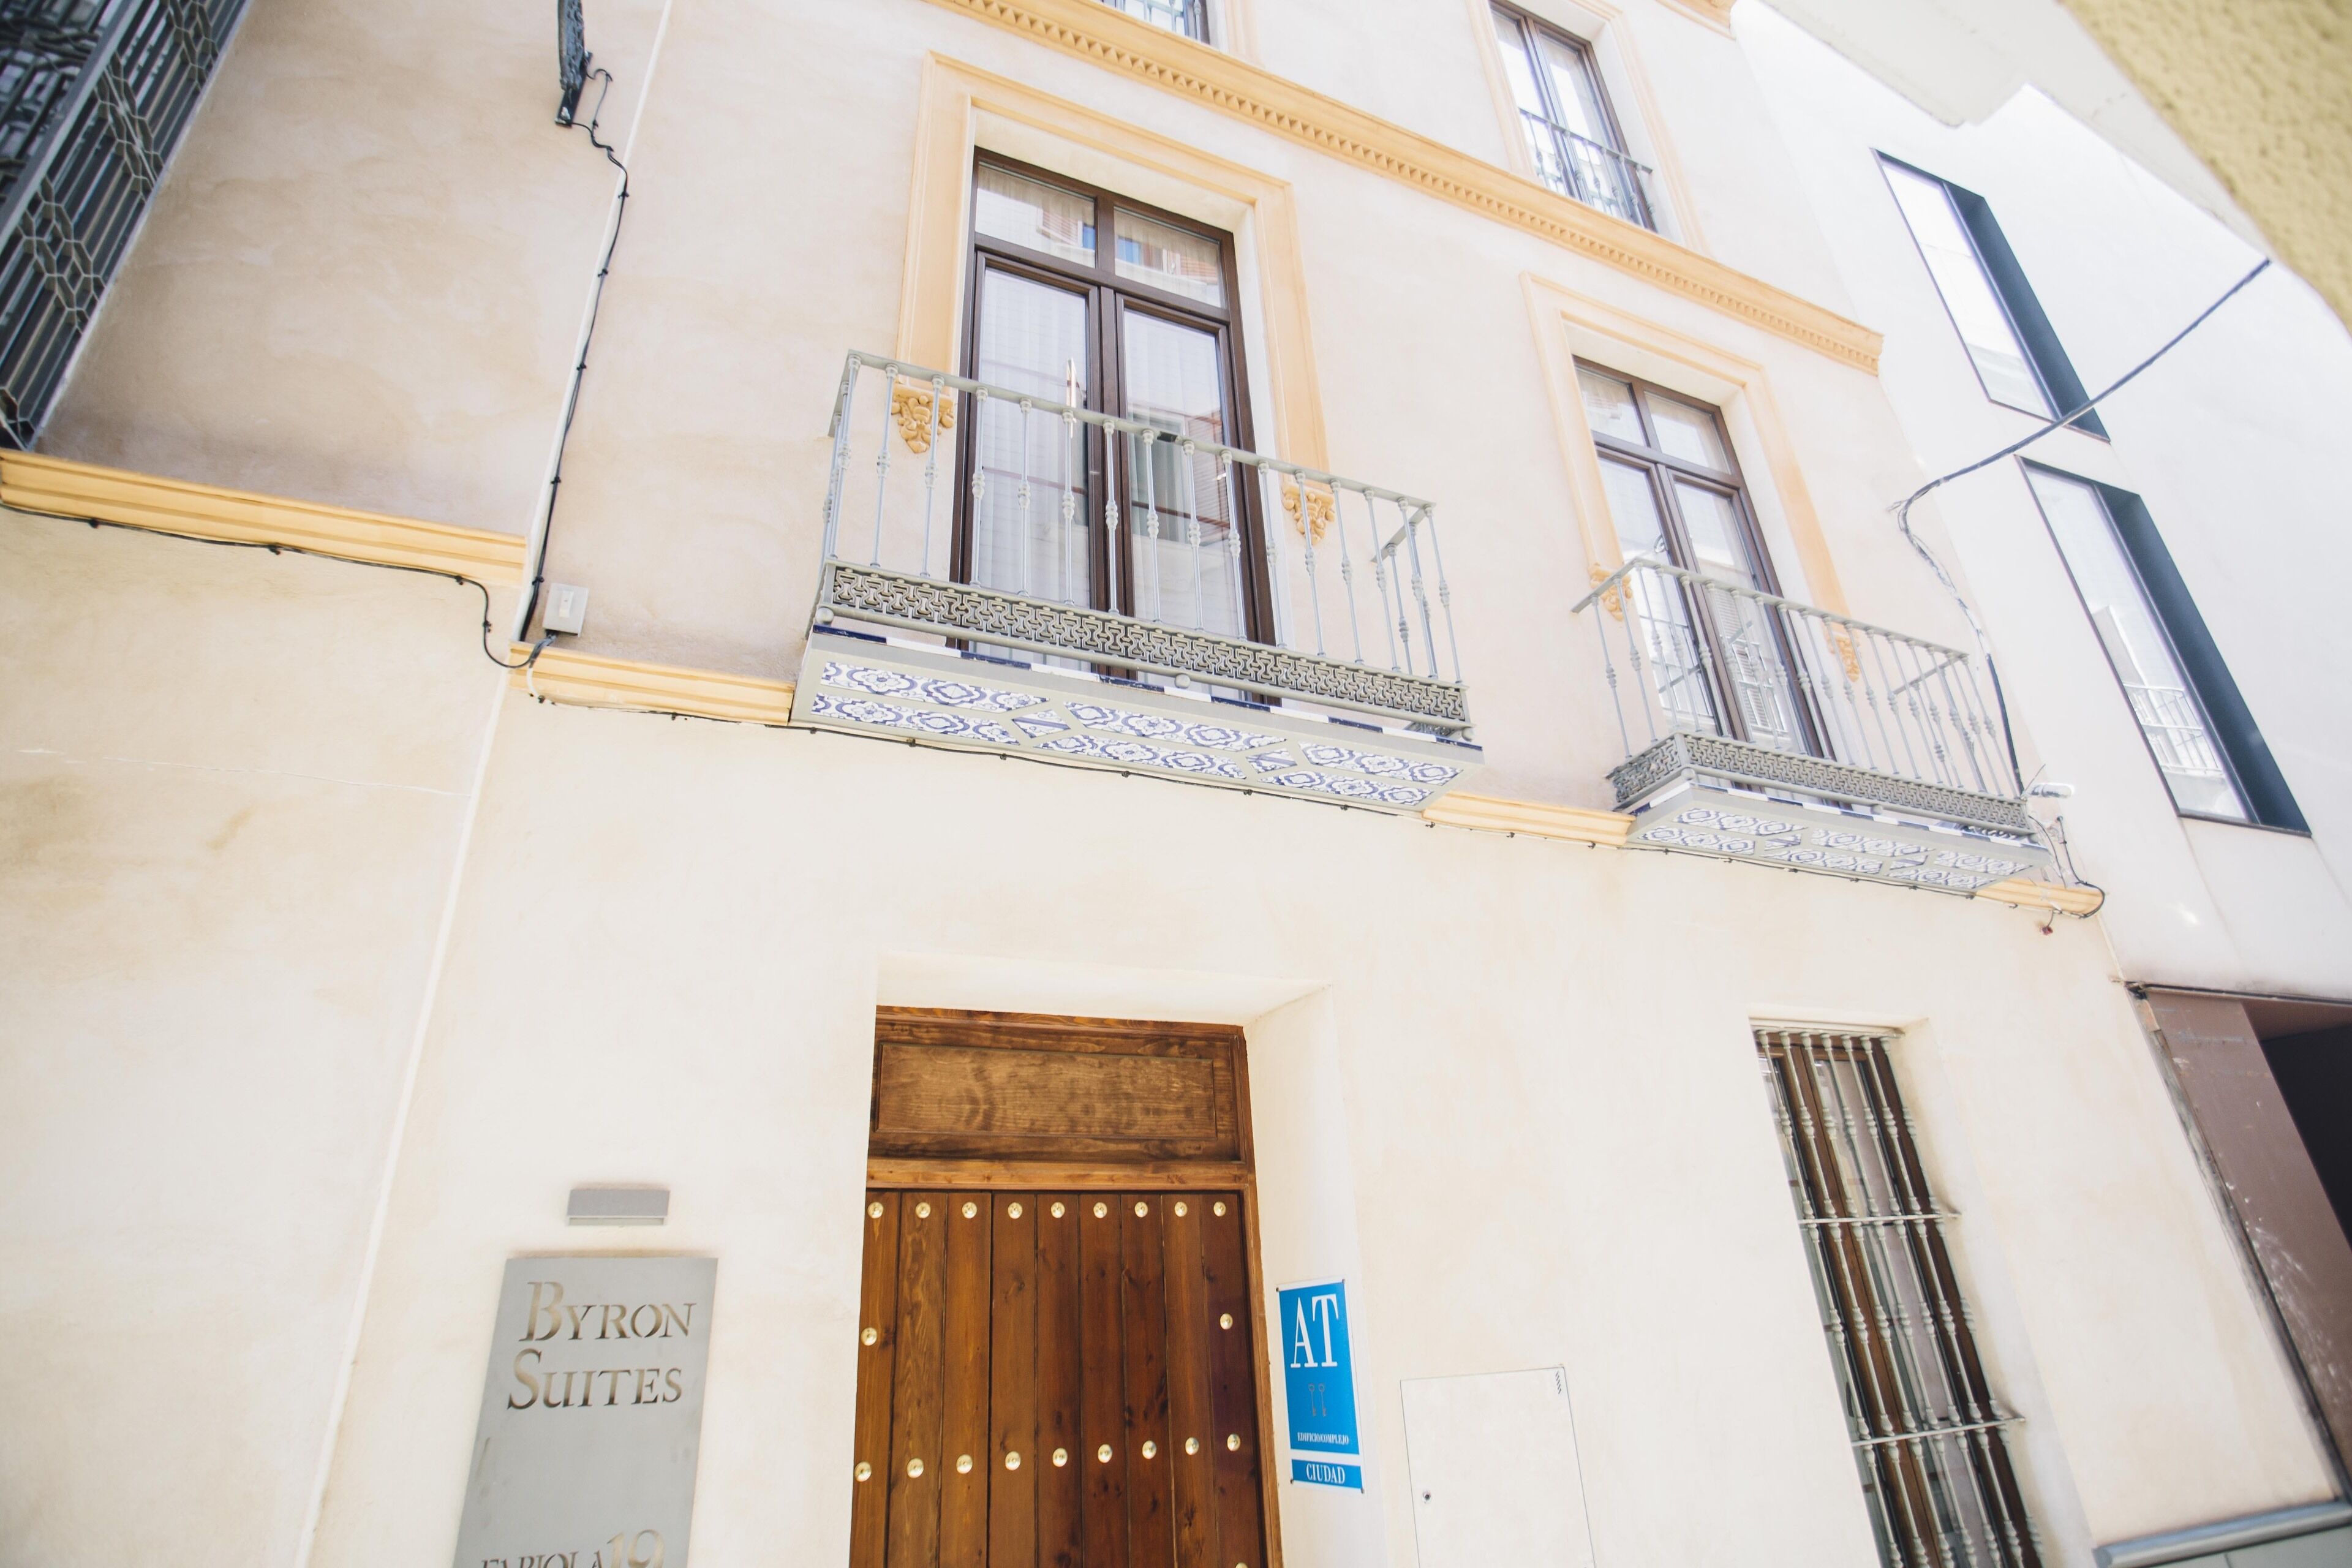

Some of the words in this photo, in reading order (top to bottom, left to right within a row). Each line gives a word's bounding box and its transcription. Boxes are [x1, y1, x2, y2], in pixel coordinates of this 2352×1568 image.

[518, 1281, 696, 1341] BYRON
[1291, 1293, 1338, 1368] AT
[507, 1348, 682, 1409] SUITES
[1306, 1463, 1345, 1483] CIUDAD
